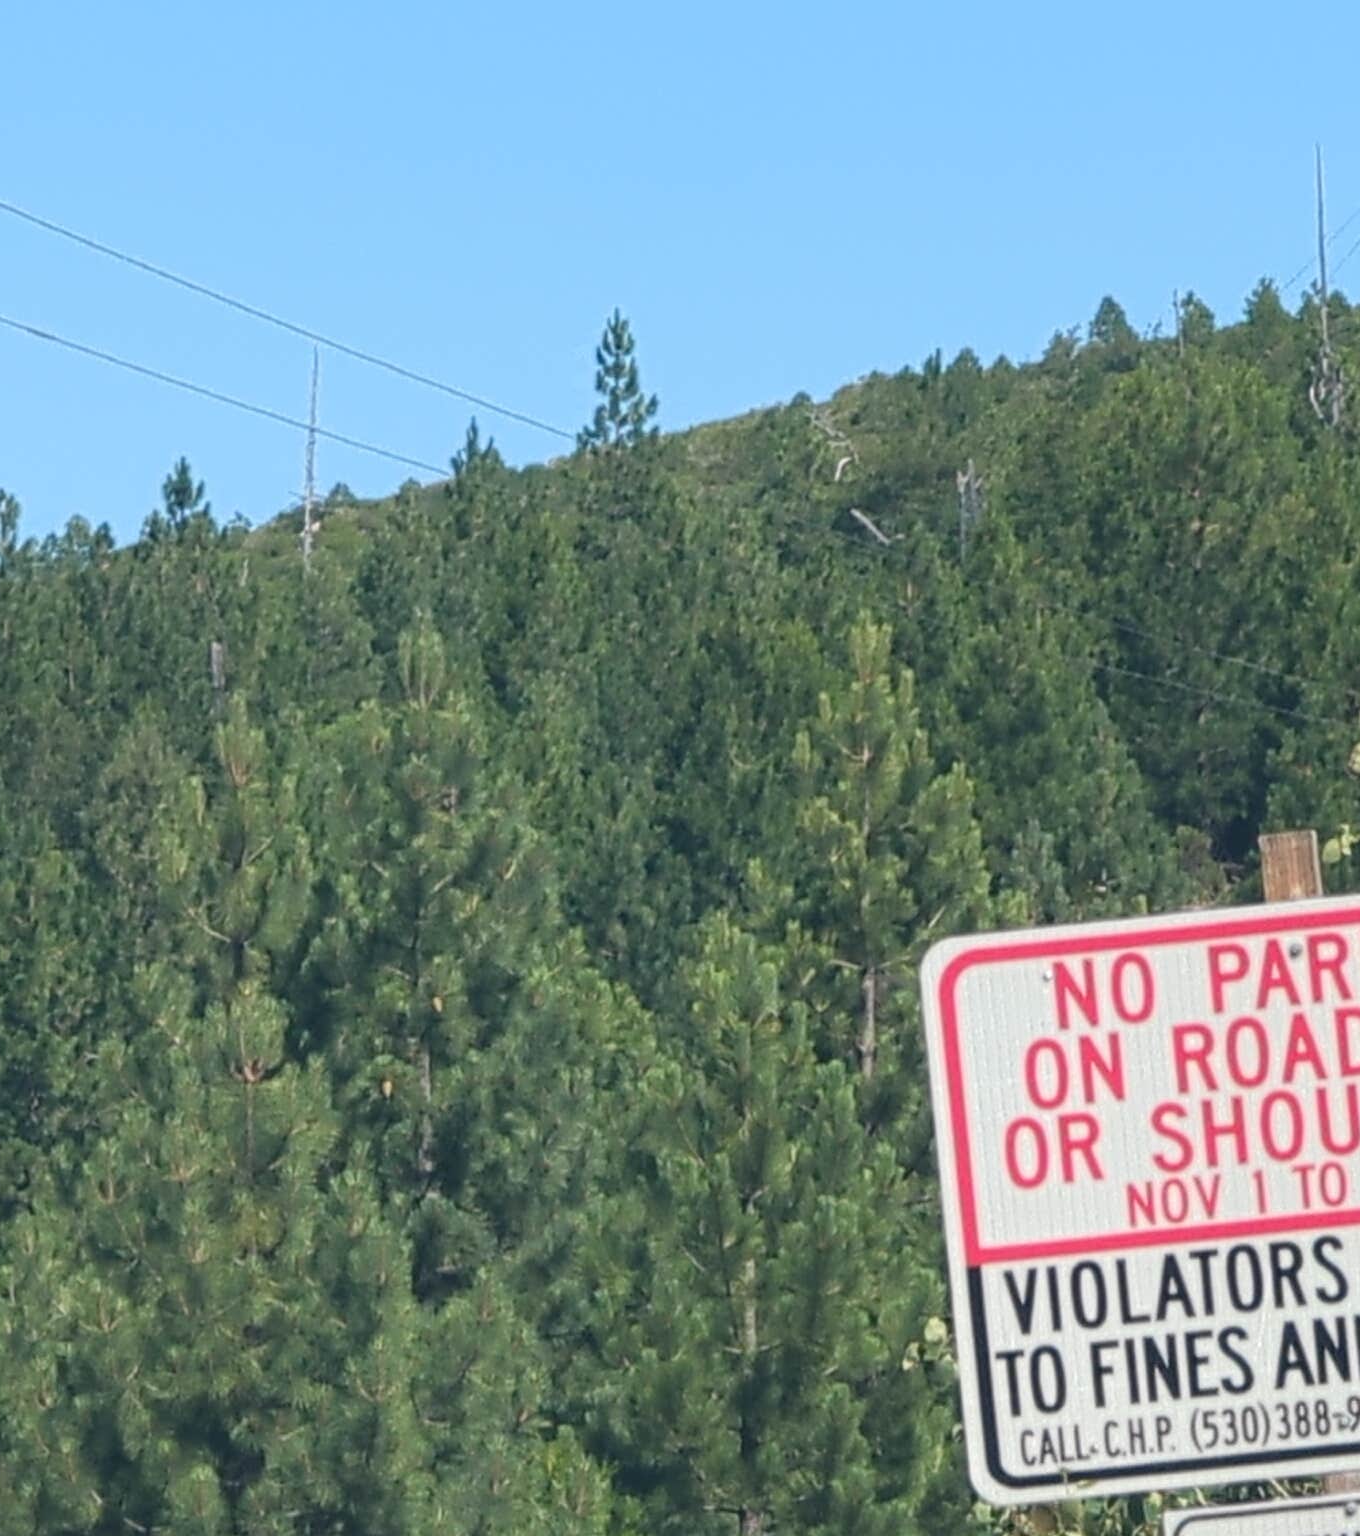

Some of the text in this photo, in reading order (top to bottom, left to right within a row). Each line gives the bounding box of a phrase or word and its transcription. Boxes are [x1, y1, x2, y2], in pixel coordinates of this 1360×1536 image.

[1053, 952, 1154, 1030] NO
[1025, 1032, 1125, 1110] ON
[1005, 1113, 1103, 1189] OR
[1127, 1174, 1220, 1227] NOV
[1253, 1169, 1267, 1215] 1
[1293, 1162, 1347, 1210] TO
[1003, 1235, 1349, 1335] VIOLATORS
[995, 1345, 1066, 1417] TO
[1090, 1326, 1254, 1408] FINES
[1103, 1415, 1176, 1458] C.H.P.
